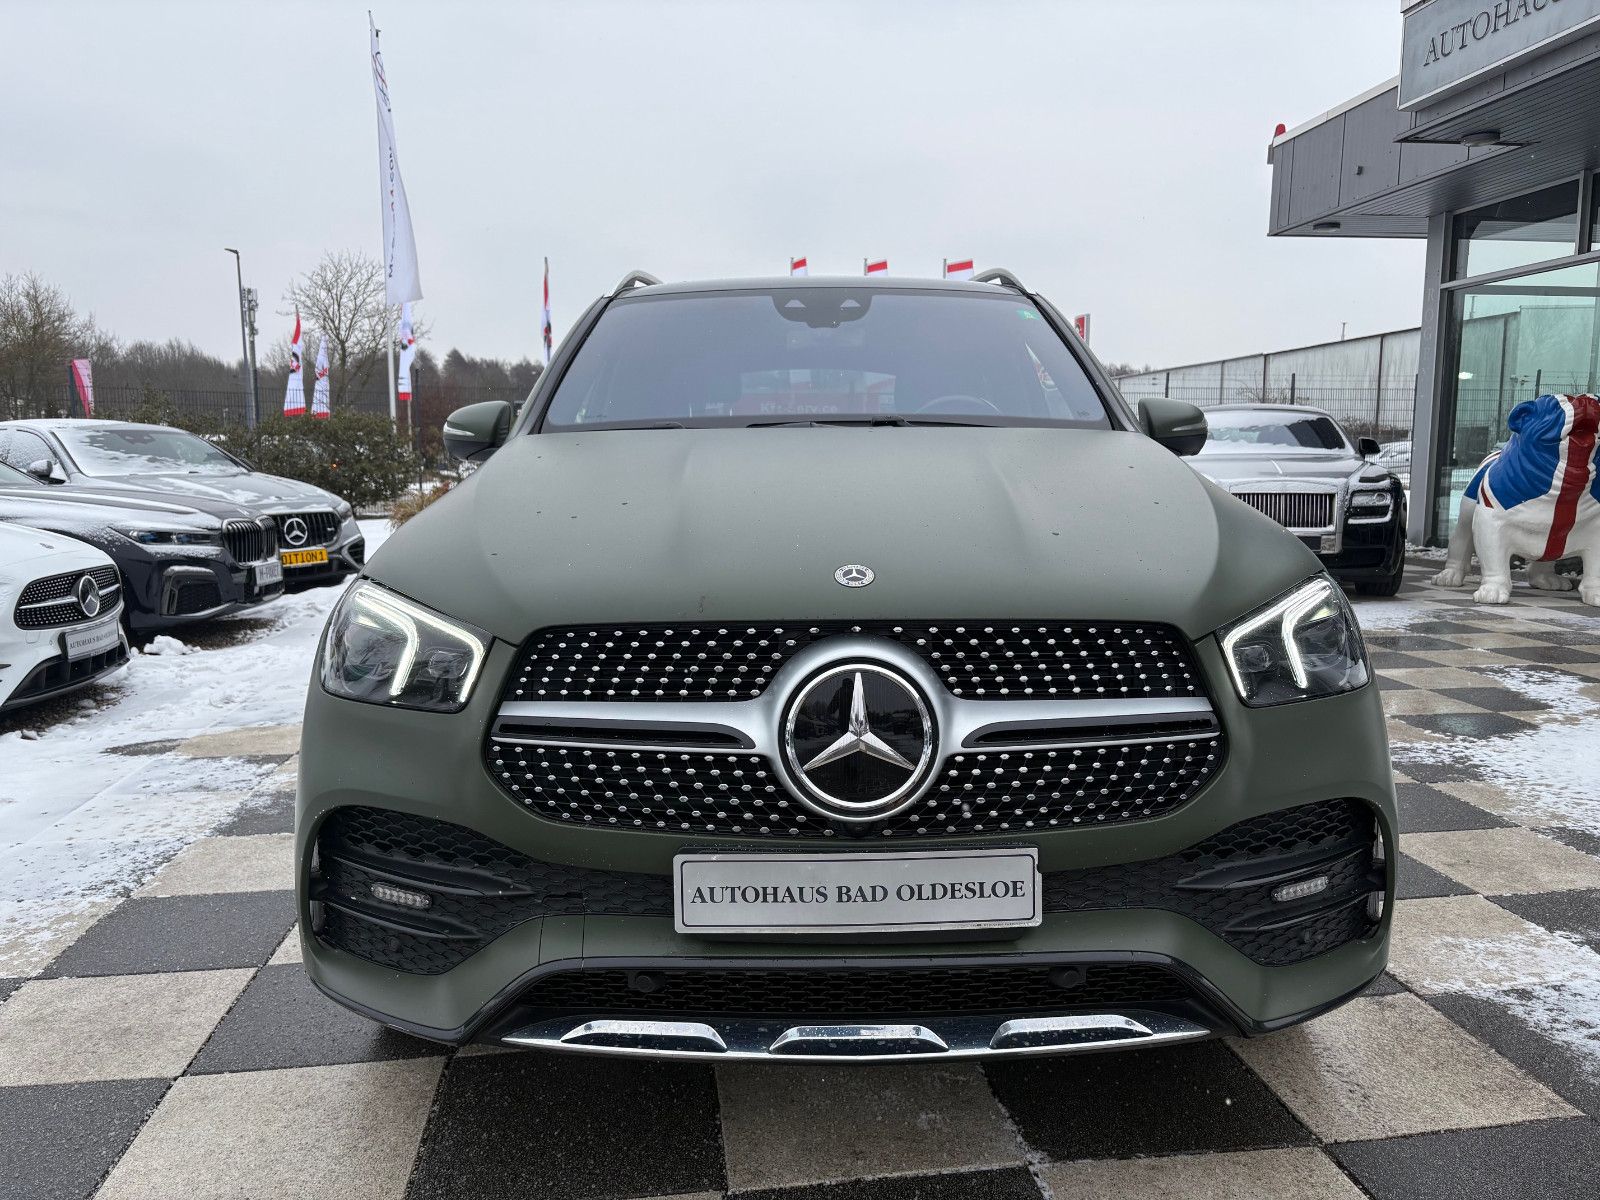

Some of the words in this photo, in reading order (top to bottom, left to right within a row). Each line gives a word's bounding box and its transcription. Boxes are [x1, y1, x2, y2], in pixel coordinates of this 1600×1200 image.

[1422, 0, 1561, 67] AUTOHA
[690, 884, 829, 905] AUTOHAUS
[835, 883, 889, 904] BAD
[895, 879, 1027, 902] OLDESLOE
